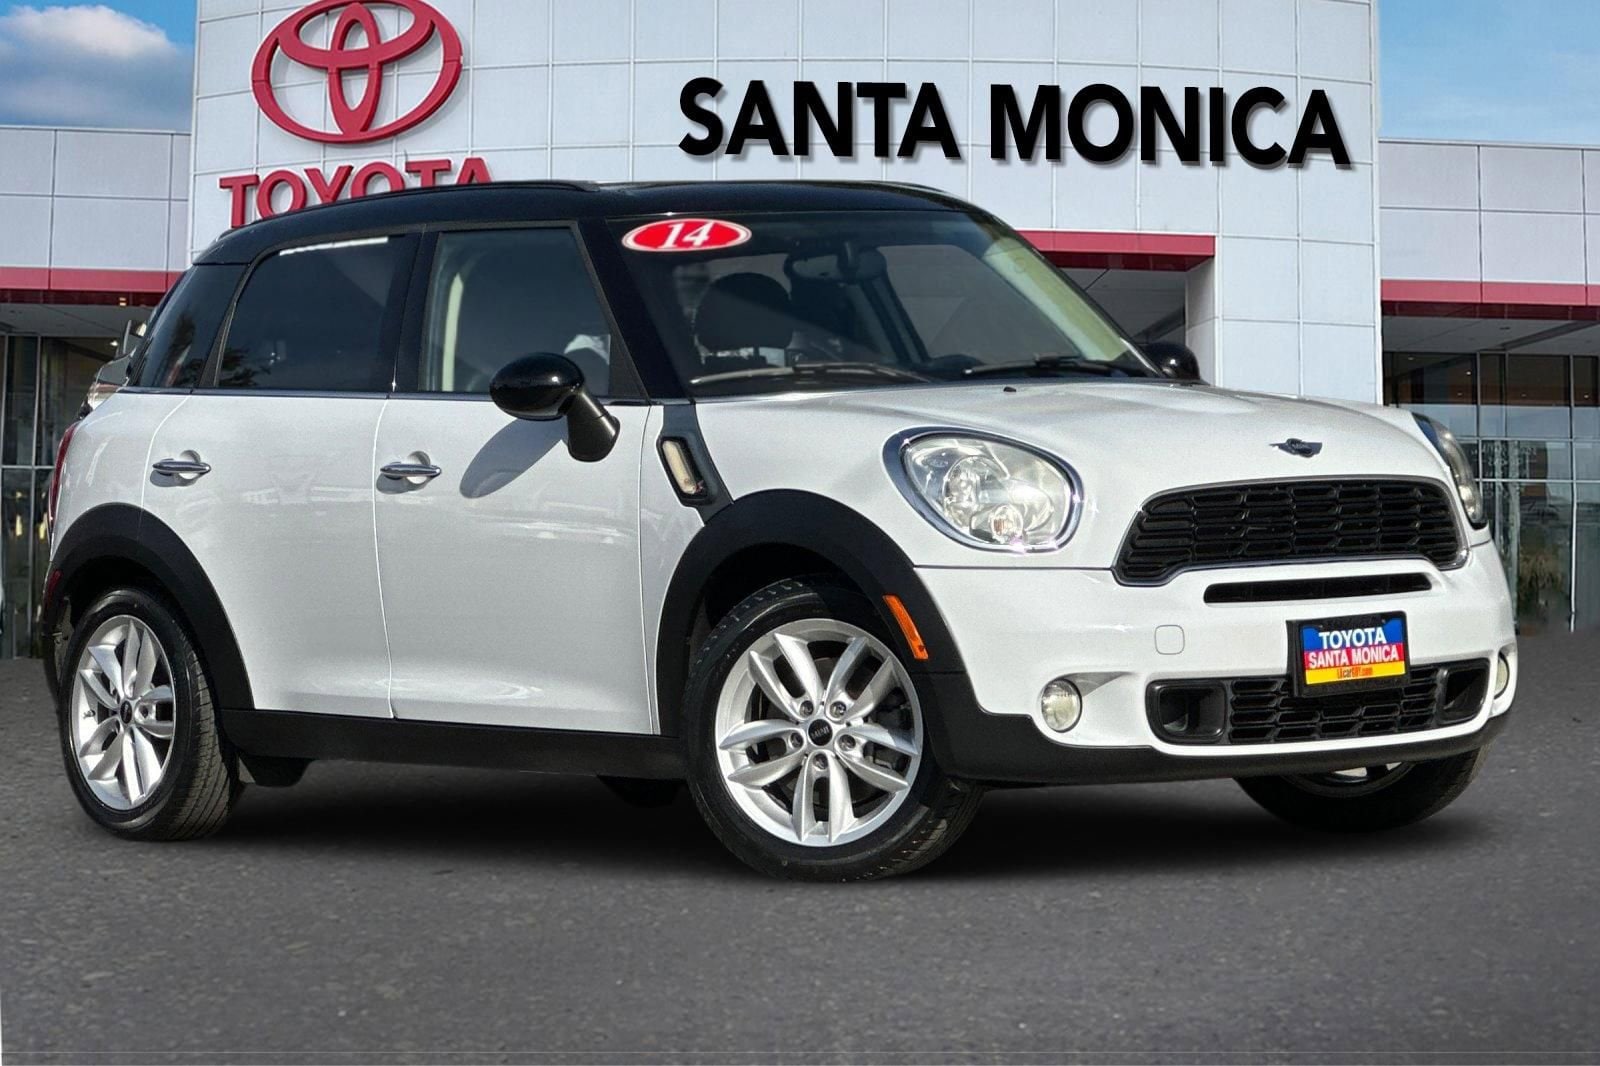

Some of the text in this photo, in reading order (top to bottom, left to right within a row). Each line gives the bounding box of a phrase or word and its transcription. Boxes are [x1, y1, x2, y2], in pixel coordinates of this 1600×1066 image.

[679, 76, 1351, 168] SANTA MONICA
[657, 221, 714, 248] 14
[1318, 627, 1388, 649] TOYOTA
[1308, 645, 1400, 669] SANTA MONICA
